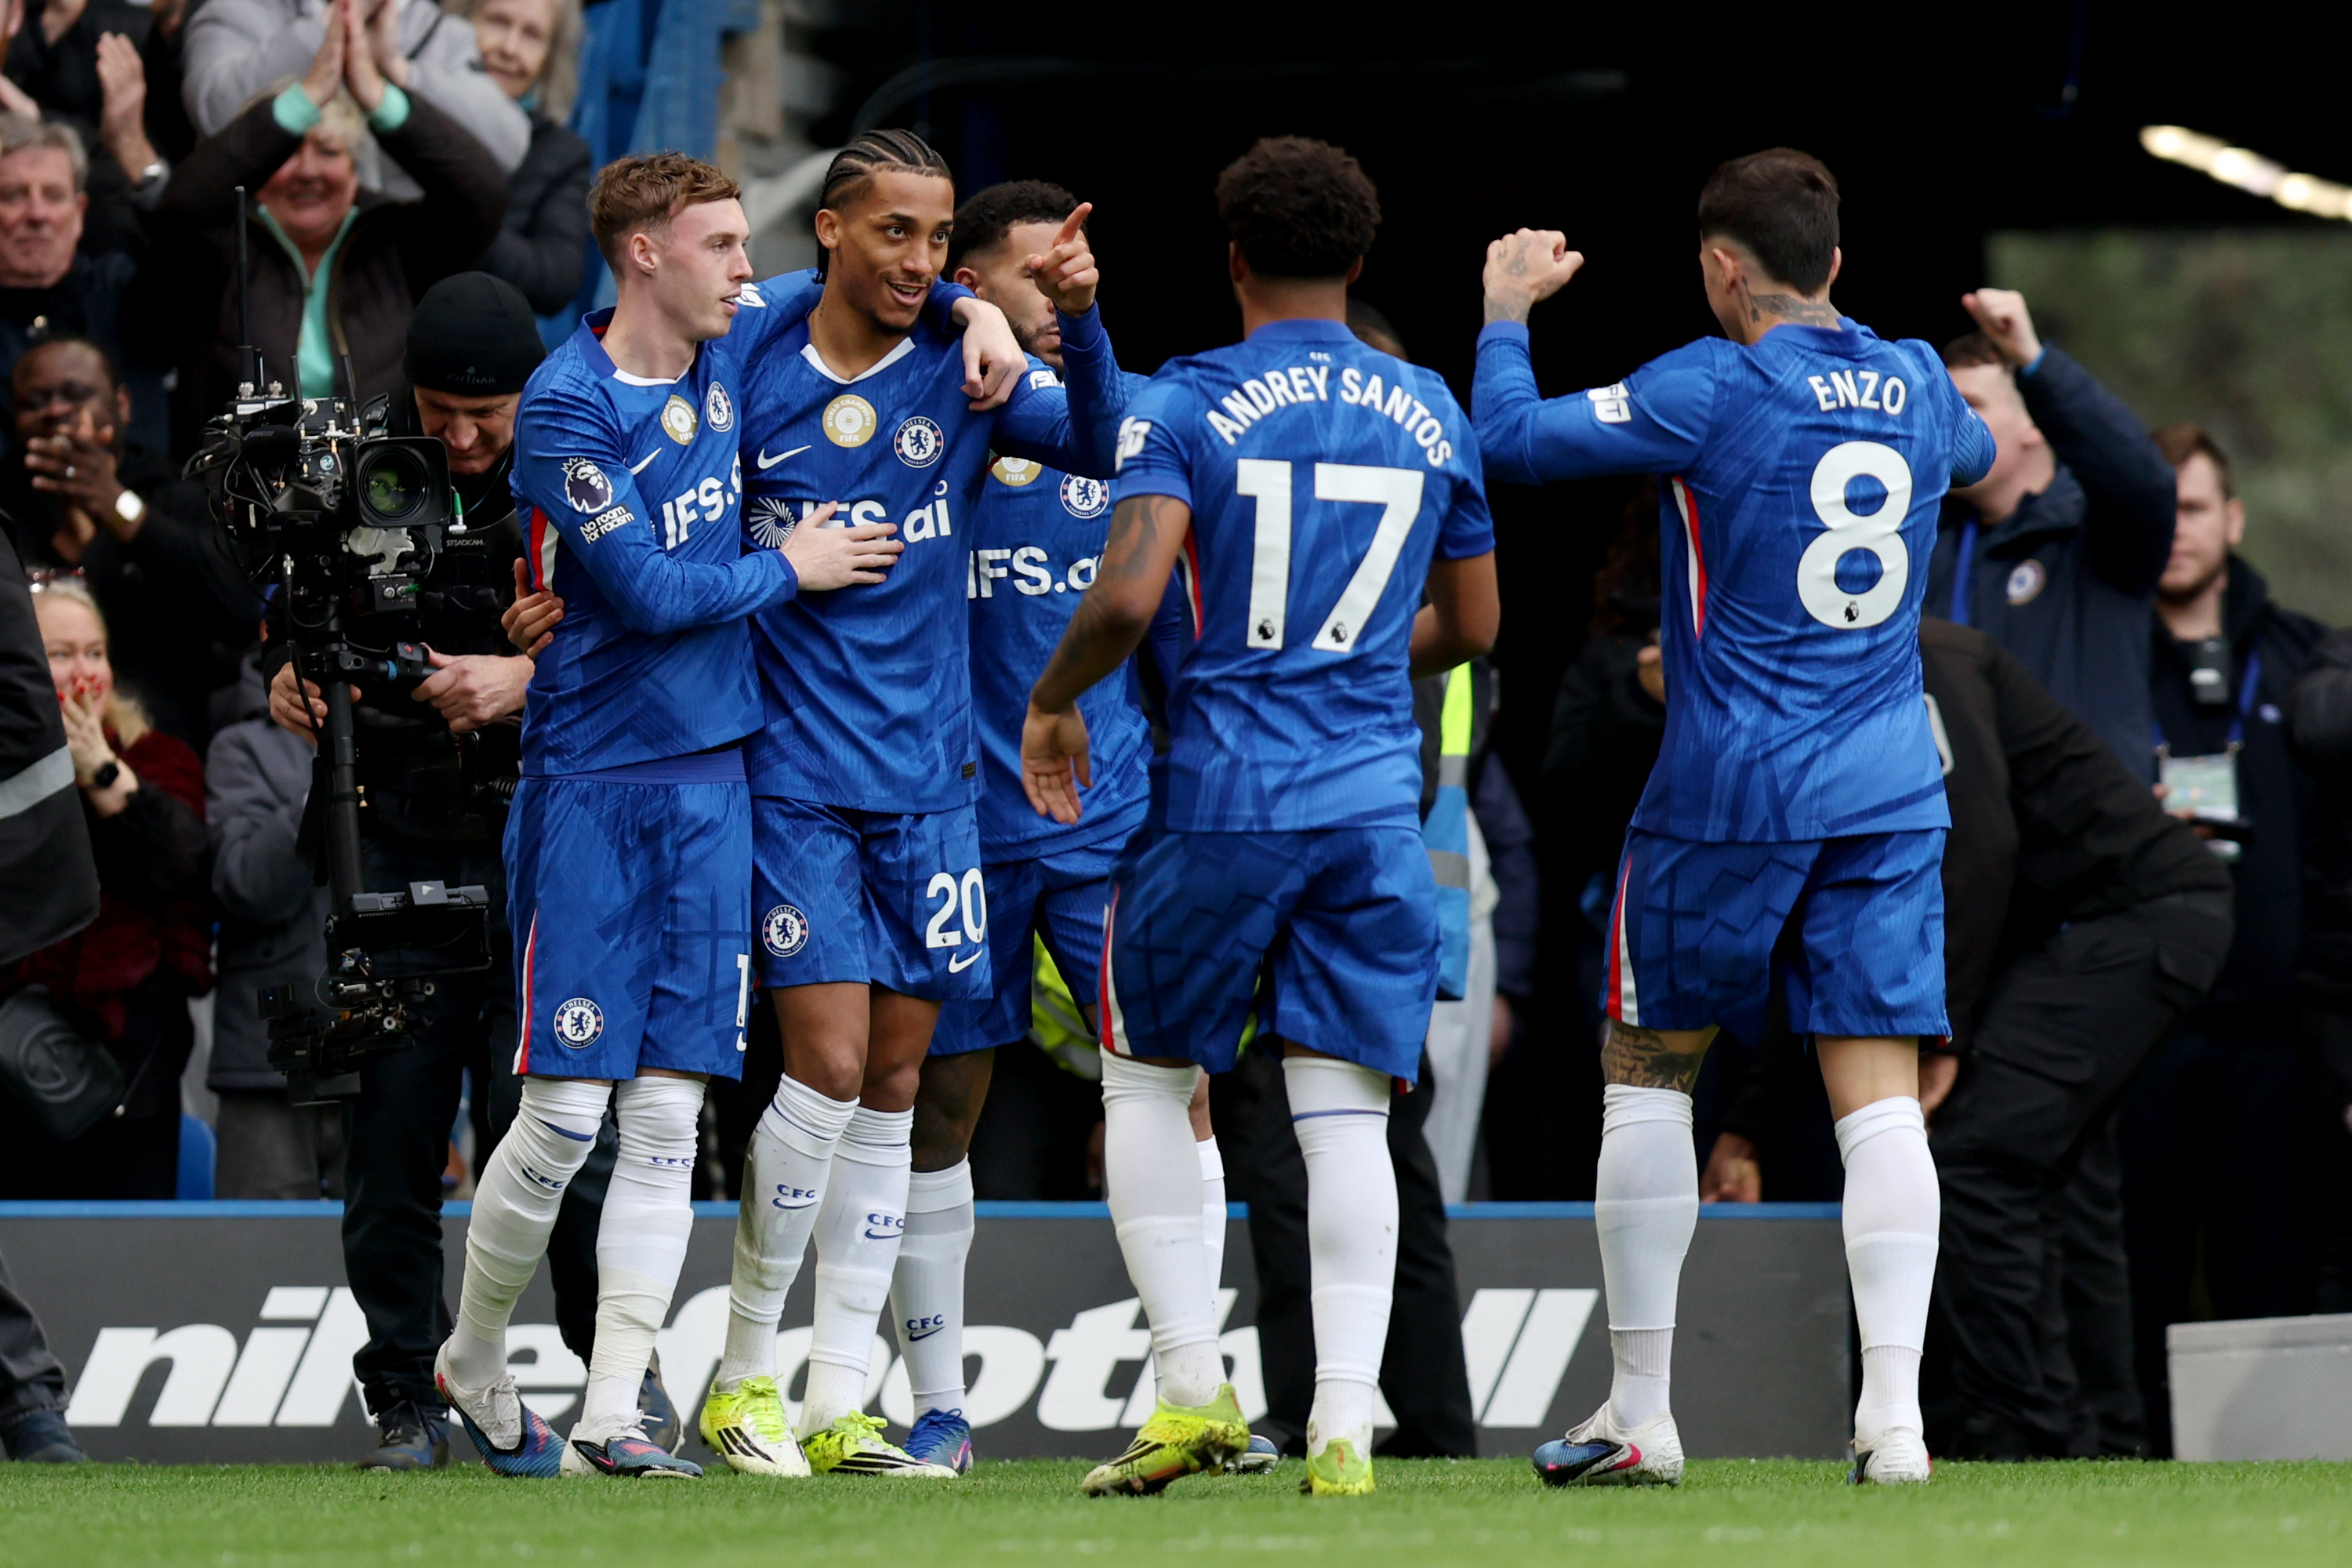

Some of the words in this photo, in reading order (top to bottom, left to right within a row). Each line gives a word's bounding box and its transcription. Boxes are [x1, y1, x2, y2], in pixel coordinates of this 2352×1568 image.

[1808, 369, 1907, 416] ENZO
[826, 403, 840, 427] WORLD
[840, 398, 872, 426] CHAMPIONS
[902, 418, 931, 432] CHELSEA
[1207, 365, 1330, 446] ANDREY
[1341, 368, 1453, 467] SANTOS
[678, 432, 694, 441] FIFA
[579, 521, 597, 536] No
[596, 506, 626, 526] room
[585, 528, 600, 544] for
[600, 513, 635, 535] racism
[1797, 441, 1913, 630] 8
[1236, 458, 1425, 653] 17
[768, 907, 797, 921] CHELSEA
[926, 867, 987, 949] 20
[563, 1000, 595, 1012] CHELSEA
[777, 1184, 815, 1199] CFC
[867, 1213, 904, 1229] CFC
[906, 1314, 944, 1330] CFC
